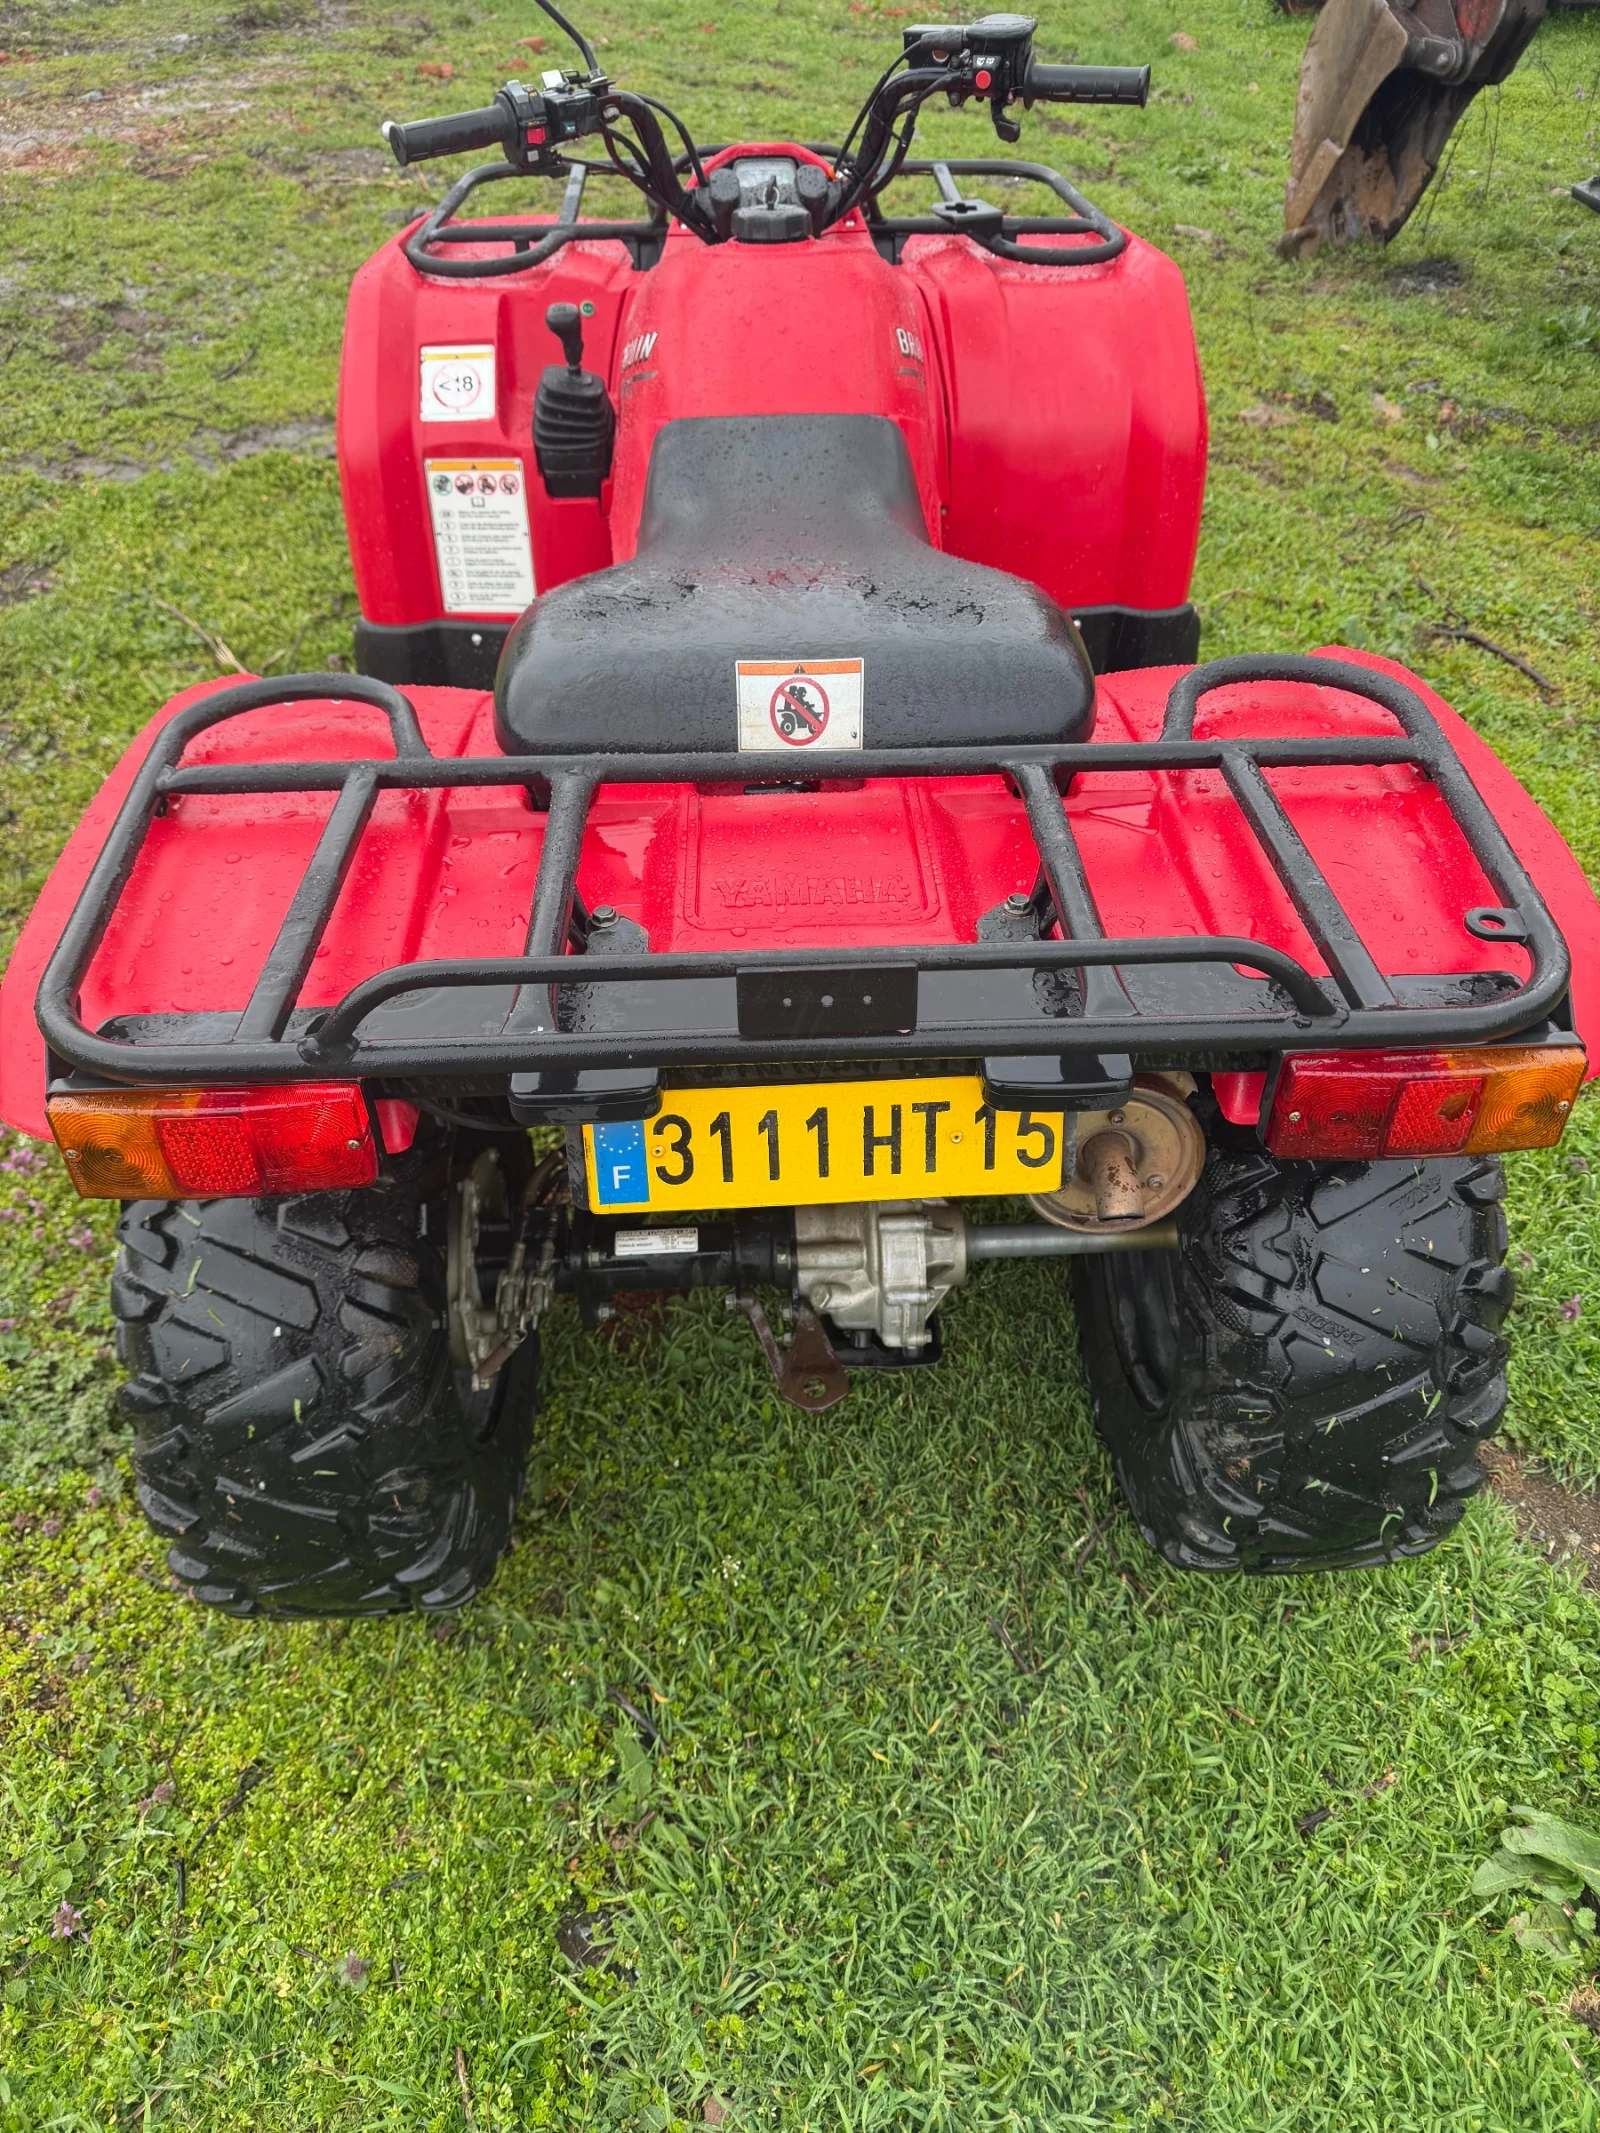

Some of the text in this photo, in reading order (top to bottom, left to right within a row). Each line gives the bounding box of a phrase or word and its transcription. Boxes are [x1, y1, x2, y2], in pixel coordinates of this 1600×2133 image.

[714, 877, 909, 908] YAMAHA
[652, 1100, 1056, 1186] 3111 HT 15
[612, 1164, 632, 1190] F
